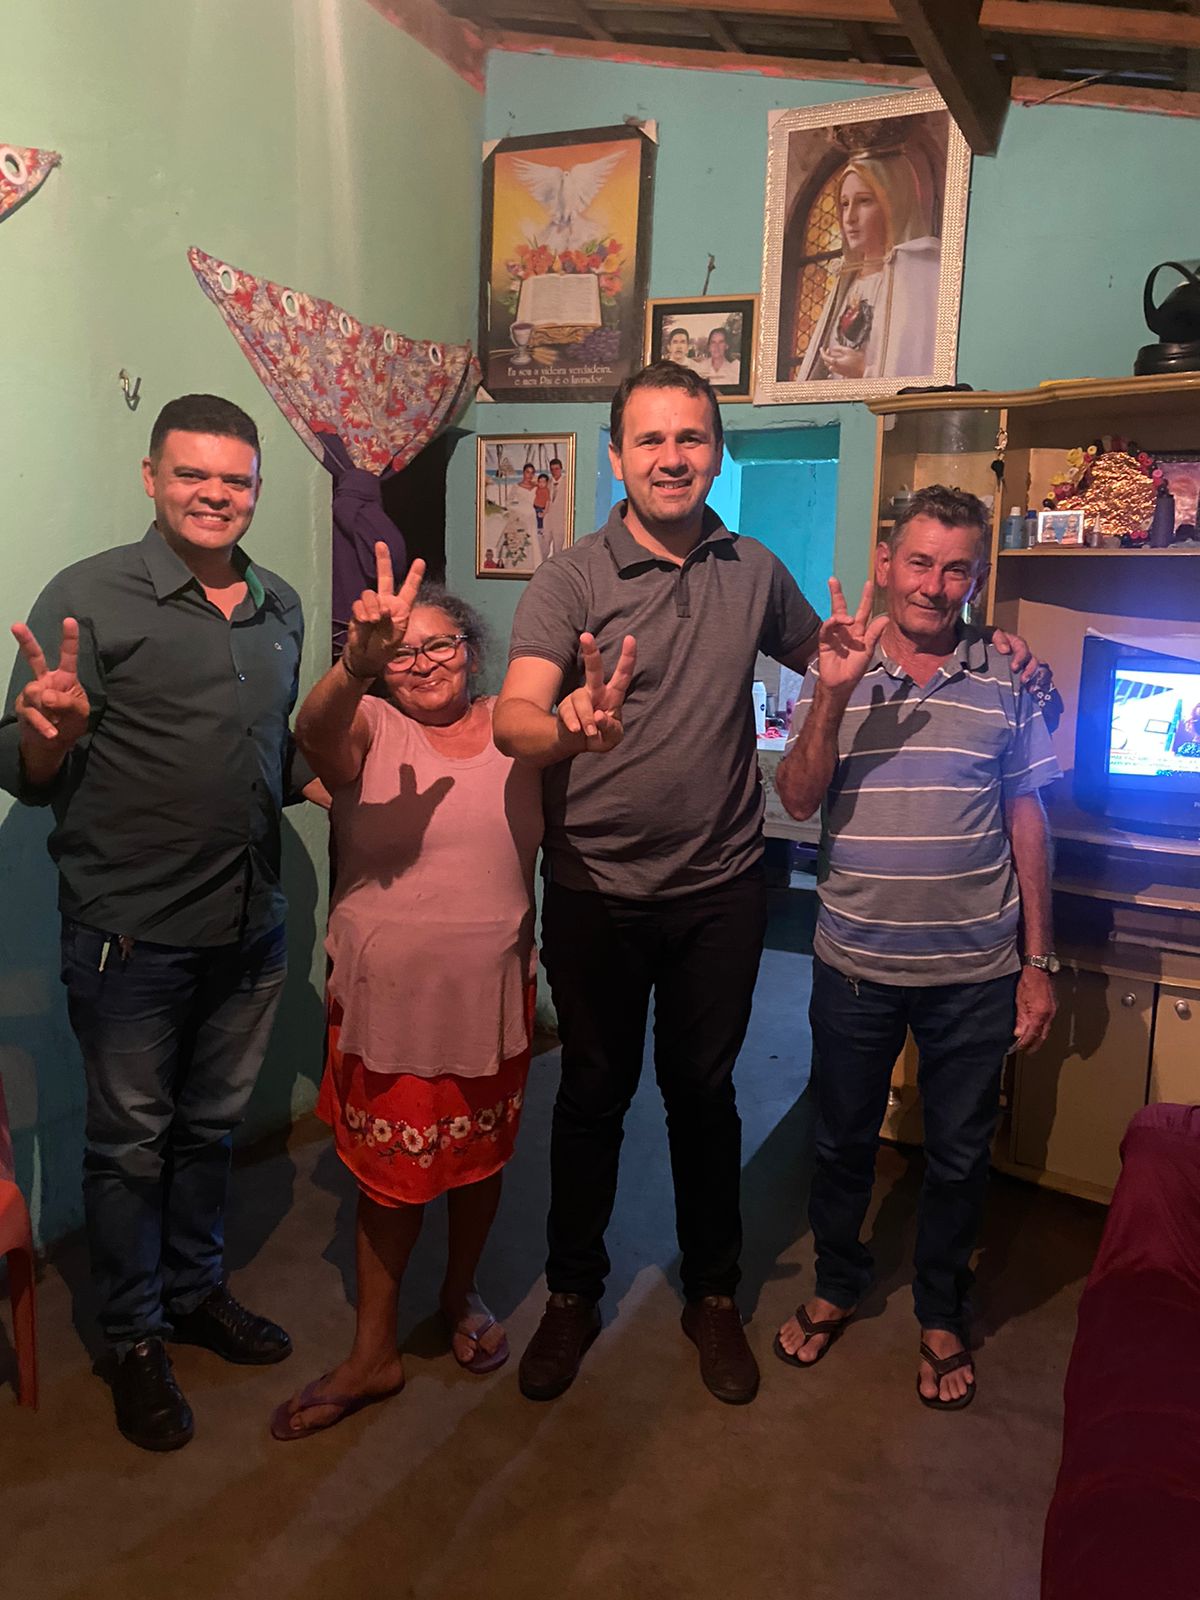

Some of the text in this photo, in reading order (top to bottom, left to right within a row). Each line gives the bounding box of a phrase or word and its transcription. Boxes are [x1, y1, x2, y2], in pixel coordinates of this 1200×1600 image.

[518, 368, 531, 376] sou
[541, 366, 567, 375] videira
[540, 376, 552, 385] Pai
